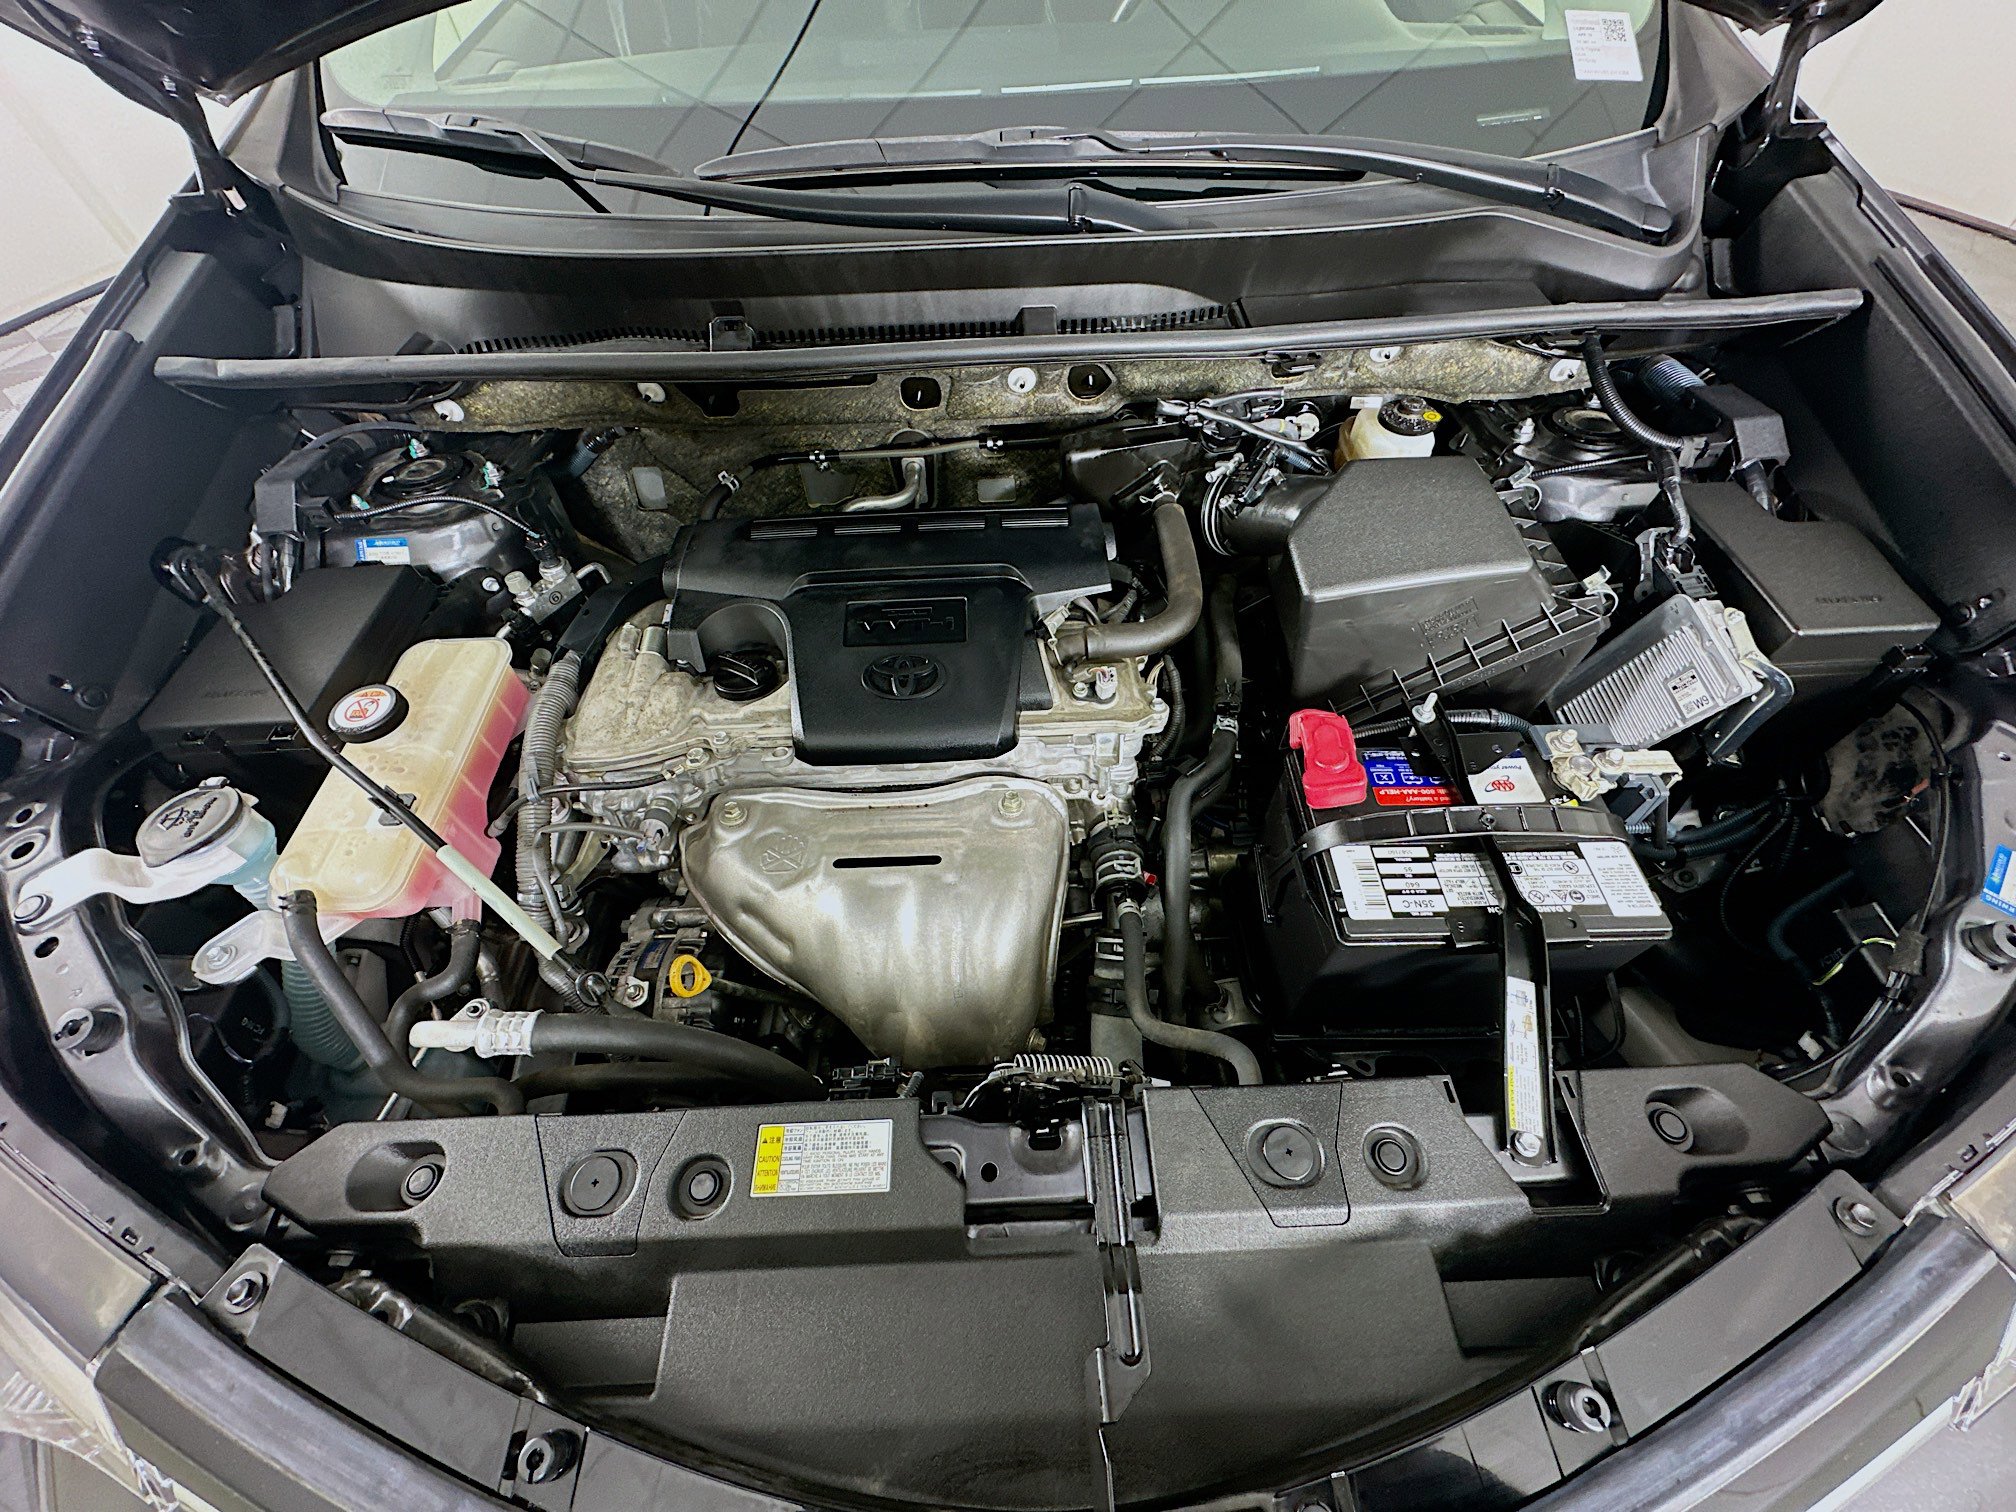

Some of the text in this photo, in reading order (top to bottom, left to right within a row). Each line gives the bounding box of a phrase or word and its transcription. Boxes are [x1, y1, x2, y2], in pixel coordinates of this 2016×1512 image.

[552, 594, 560, 602] 6
[1693, 695, 1710, 708] W9
[1402, 900, 1434, 908] 35N-C
